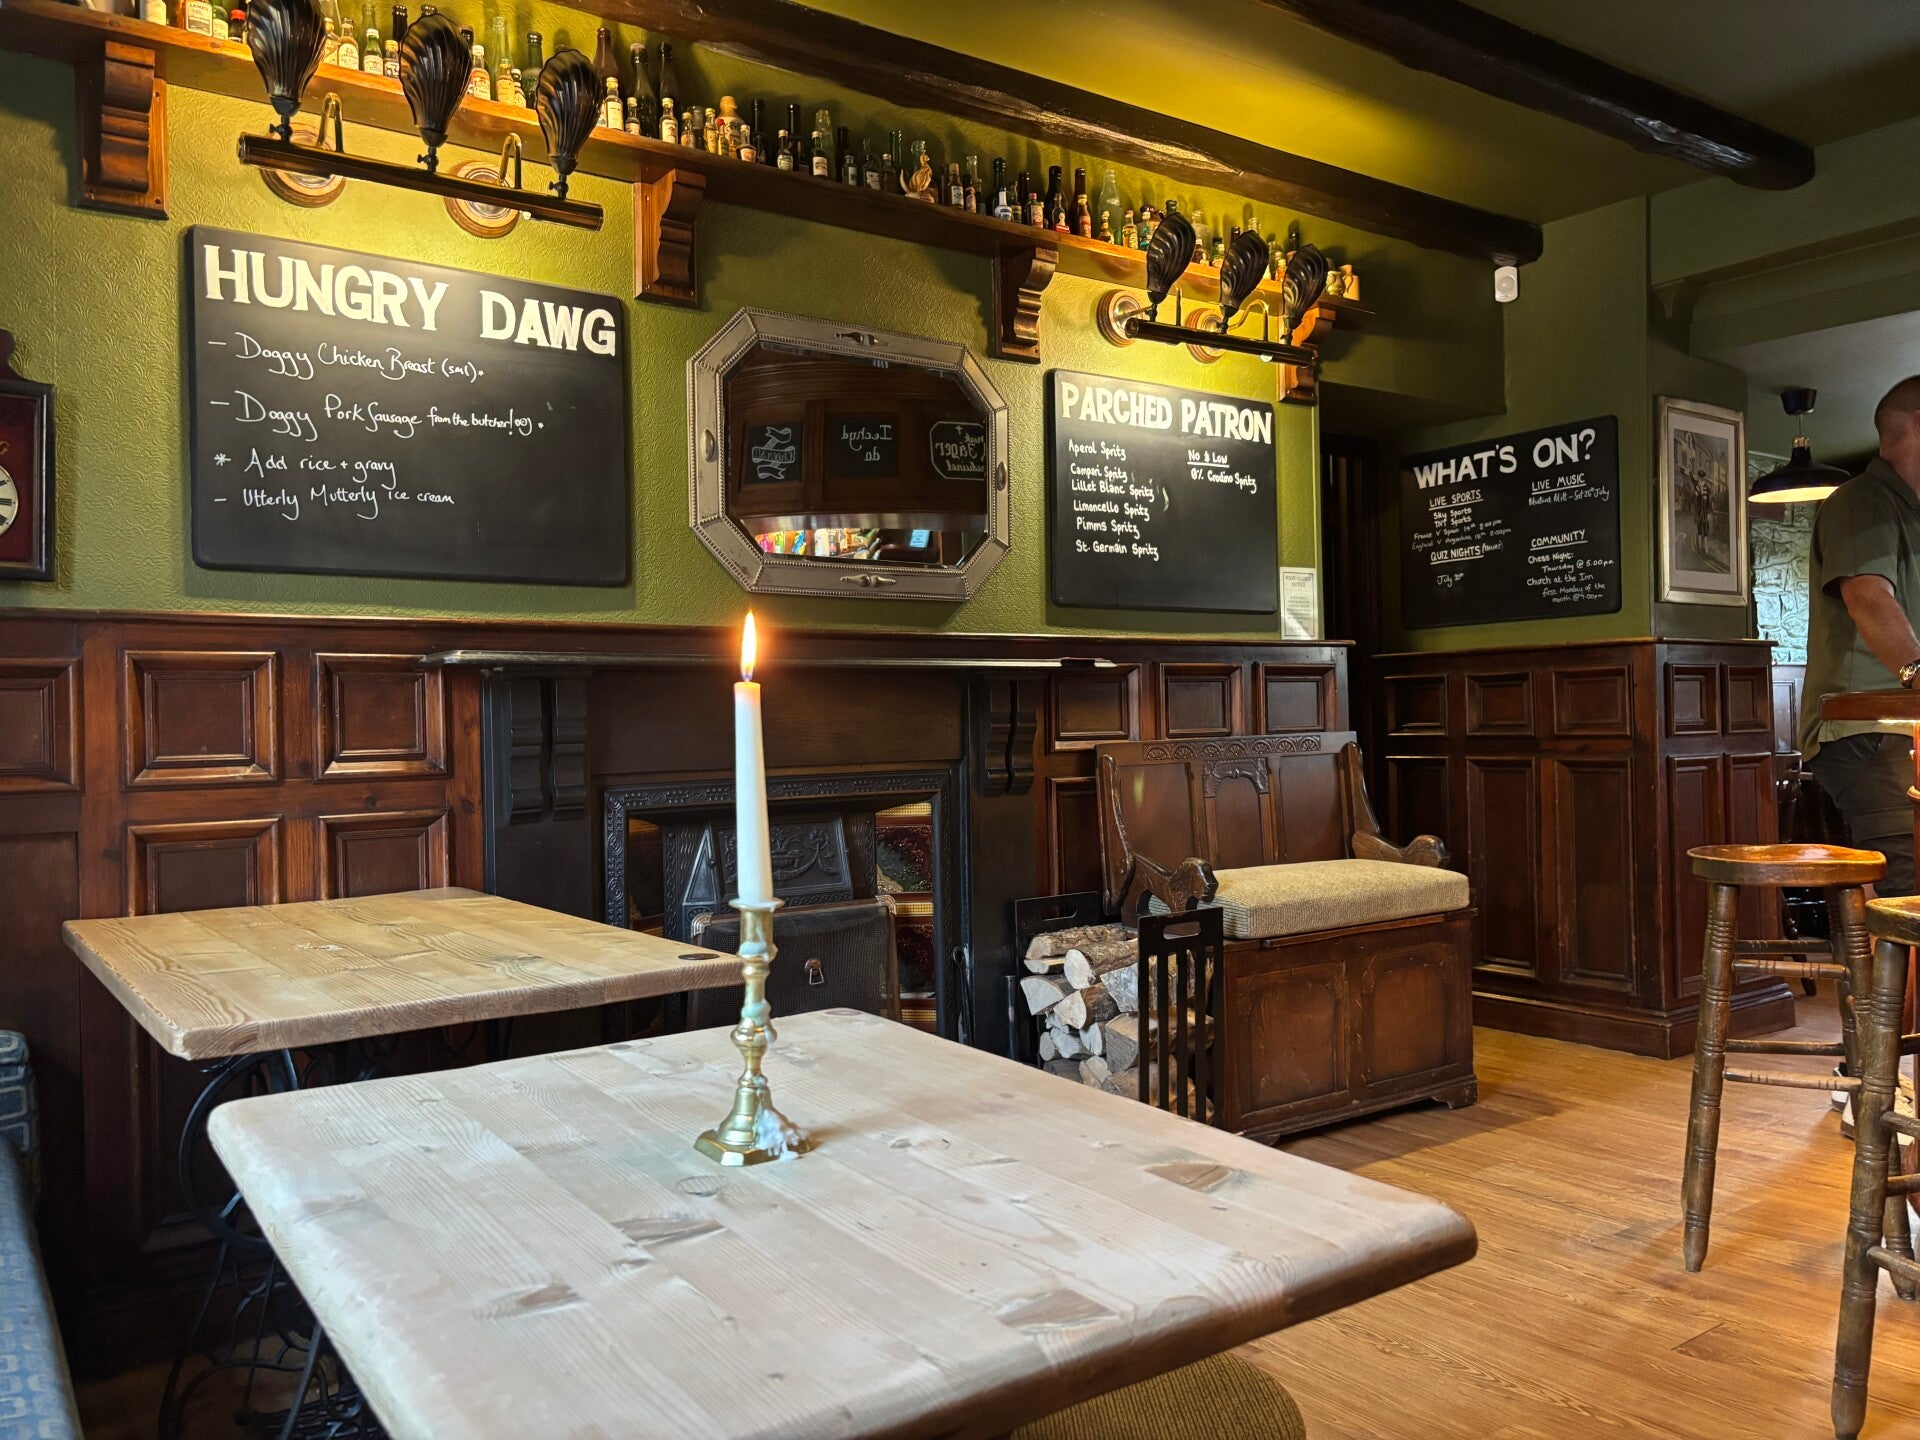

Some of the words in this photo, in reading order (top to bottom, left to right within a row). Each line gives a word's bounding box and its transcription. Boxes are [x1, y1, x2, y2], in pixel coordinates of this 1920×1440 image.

[202, 244, 449, 331] HUNGRY
[479, 290, 617, 357] DAWG
[235, 332, 315, 380] Doggy
[318, 342, 385, 370] Chicken
[381, 347, 435, 380] Breast
[234, 391, 318, 441] Doggy
[324, 394, 365, 422] Pork
[366, 402, 422, 439] Sausage
[427, 405, 451, 427] from
[453, 411, 470, 427] the
[1061, 382, 1173, 430] PARCHED
[1180, 399, 1273, 445] PATRON
[1068, 439, 1097, 456] Aperol
[1100, 441, 1126, 461] Spritz
[1187, 449, 1201, 461] No
[1212, 452, 1228, 464] Low
[1413, 444, 1518, 490] WHAT'S
[1533, 428, 1596, 469] ON?
[244, 448, 288, 478] Add
[300, 451, 337, 470] rice
[353, 460, 396, 490] gravy
[1070, 463, 1102, 481] Campari
[1104, 467, 1127, 484] Spritz
[1071, 479, 1097, 491] Lillet
[1099, 479, 1125, 495] Blanc
[1130, 484, 1154, 502] Spritz
[1234, 472, 1257, 494] Spritz
[1531, 479, 1551, 491] LIVE
[1556, 473, 1585, 488] MUSIC
[243, 487, 299, 521] Utterly
[310, 484, 379, 520] Mutterly
[388, 487, 411, 501] ice
[417, 491, 455, 504] cream
[1429, 495, 1447, 508] LIVE
[1451, 489, 1481, 503] SPORTS
[1073, 499, 1119, 514] Limoncello
[1124, 503, 1150, 522] Spritz
[1450, 507, 1472, 518] Sports
[1450, 516, 1472, 527] Sports
[1076, 517, 1107, 531] Pimms
[1111, 519, 1140, 540] Spritz
[1531, 529, 1586, 548] COMMUNITY
[1132, 544, 1159, 561] Spritz
[1430, 550, 1449, 561] QUIZ
[1450, 545, 1481, 558] NIGHTS
